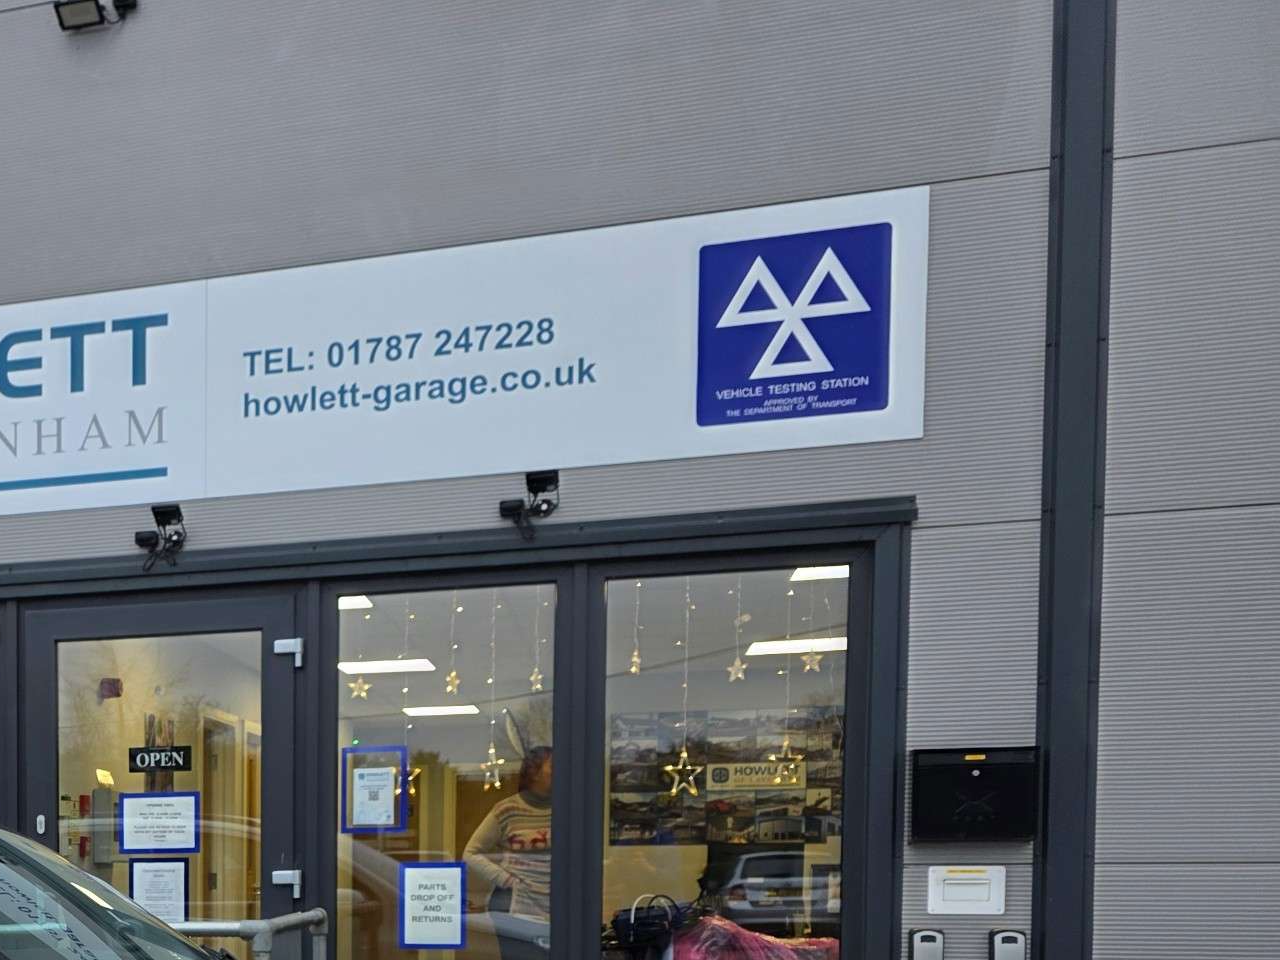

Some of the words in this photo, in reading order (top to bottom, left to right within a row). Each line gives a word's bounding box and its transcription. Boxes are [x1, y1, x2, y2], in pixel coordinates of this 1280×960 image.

[242, 346, 315, 377] TEL:
[327, 332, 423, 368] 01787
[433, 317, 555, 357] 247228
[242, 357, 597, 418] howlett-garage.co.uk
[715, 386, 763, 401] VEHICLE
[767, 380, 817, 395] TESTING
[820, 375, 869, 390] STATION
[726, 408, 741, 417] THE
[796, 402, 808, 411] OF
[135, 751, 185, 768] OPEN
[418, 883, 447, 891] PARTS
[410, 894, 435, 902] DROP
[437, 894, 455, 902] OFF
[423, 904, 442, 912] AND
[411, 915, 453, 923] RETURNS
